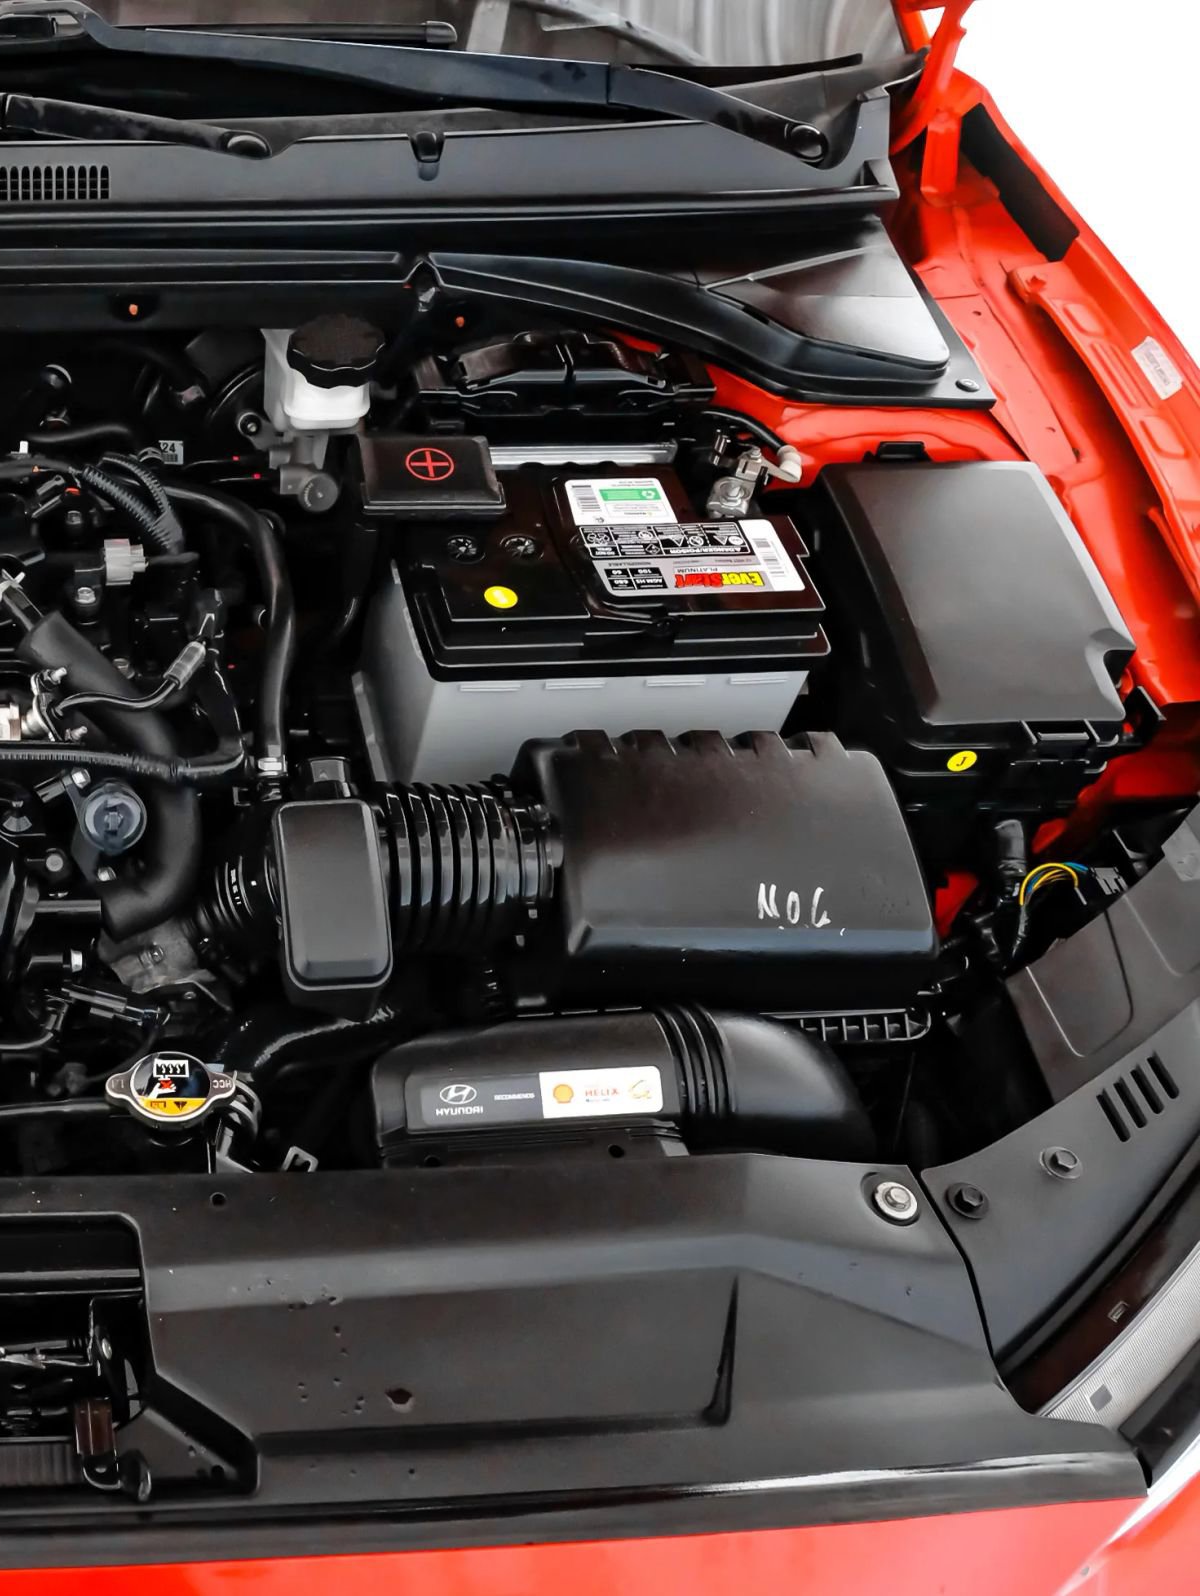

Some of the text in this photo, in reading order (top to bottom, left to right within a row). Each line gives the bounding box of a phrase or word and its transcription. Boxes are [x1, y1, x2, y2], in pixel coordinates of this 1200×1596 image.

[675, 571, 765, 588] EverStart
[585, 1088, 620, 1097] HELIX
[435, 1105, 484, 1116] HYUNDAI
